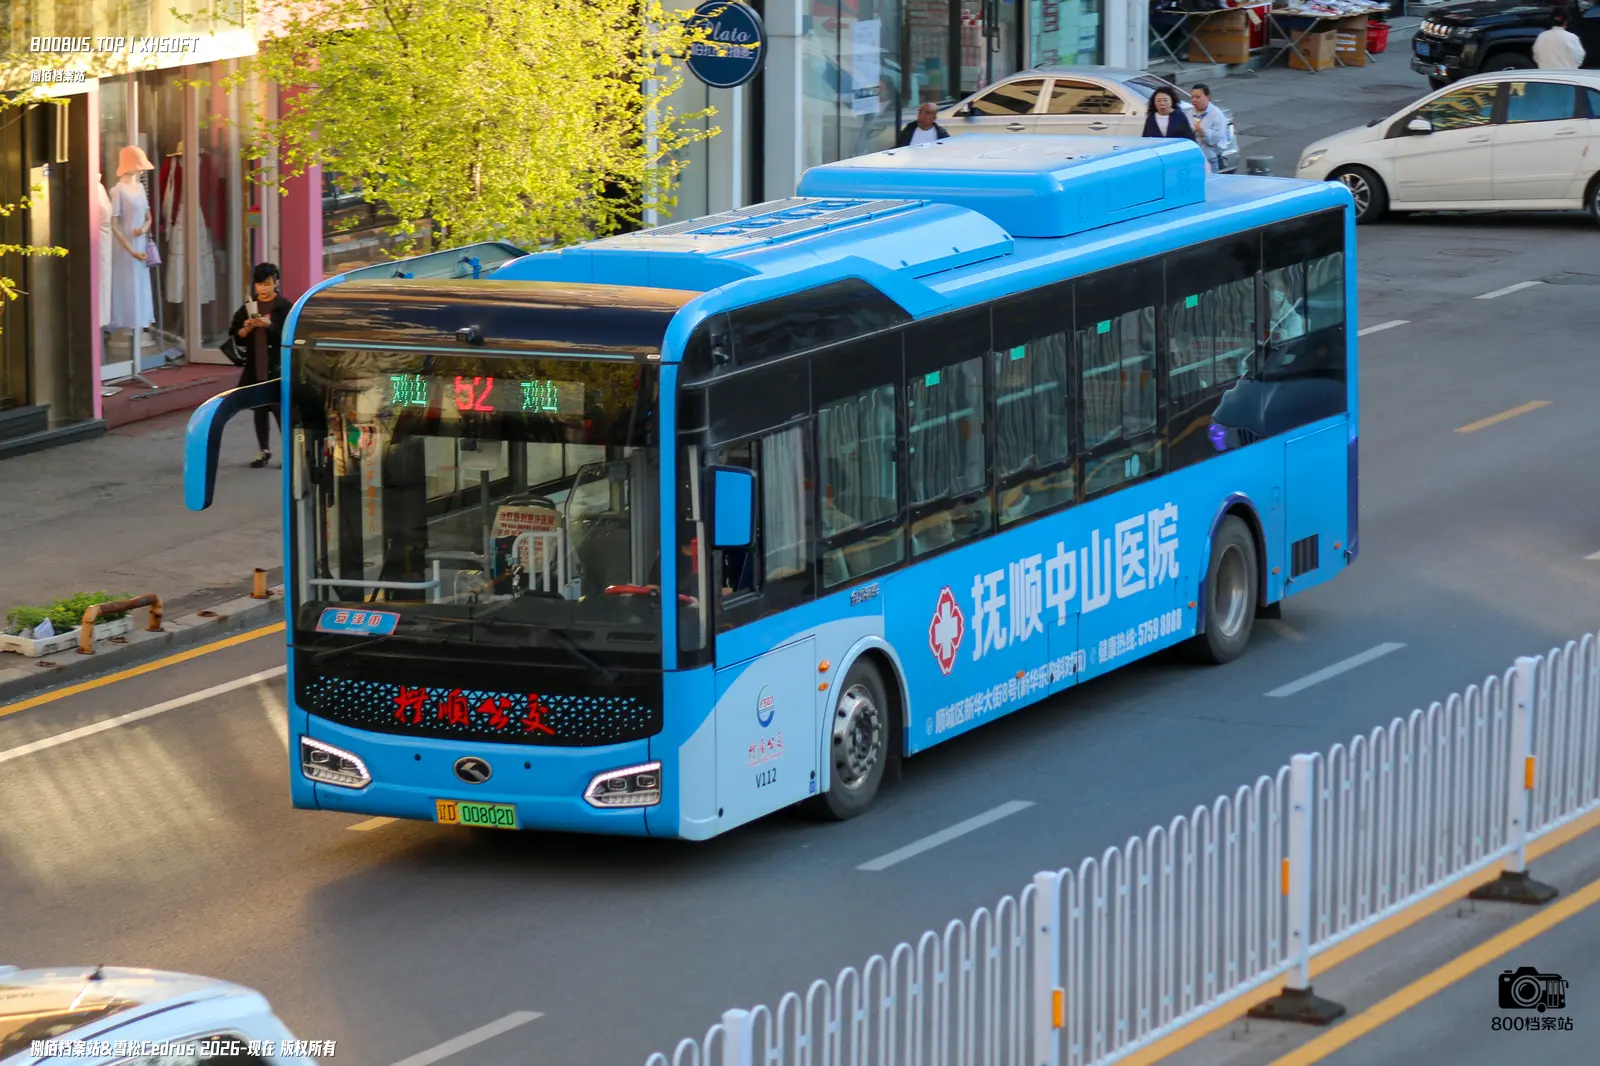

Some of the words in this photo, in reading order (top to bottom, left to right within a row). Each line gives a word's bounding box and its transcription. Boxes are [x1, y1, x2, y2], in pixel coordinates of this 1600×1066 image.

[455, 376, 495, 412] 52
[971, 501, 1180, 662] 抚顺中山医院
[756, 767, 777, 789] V112
